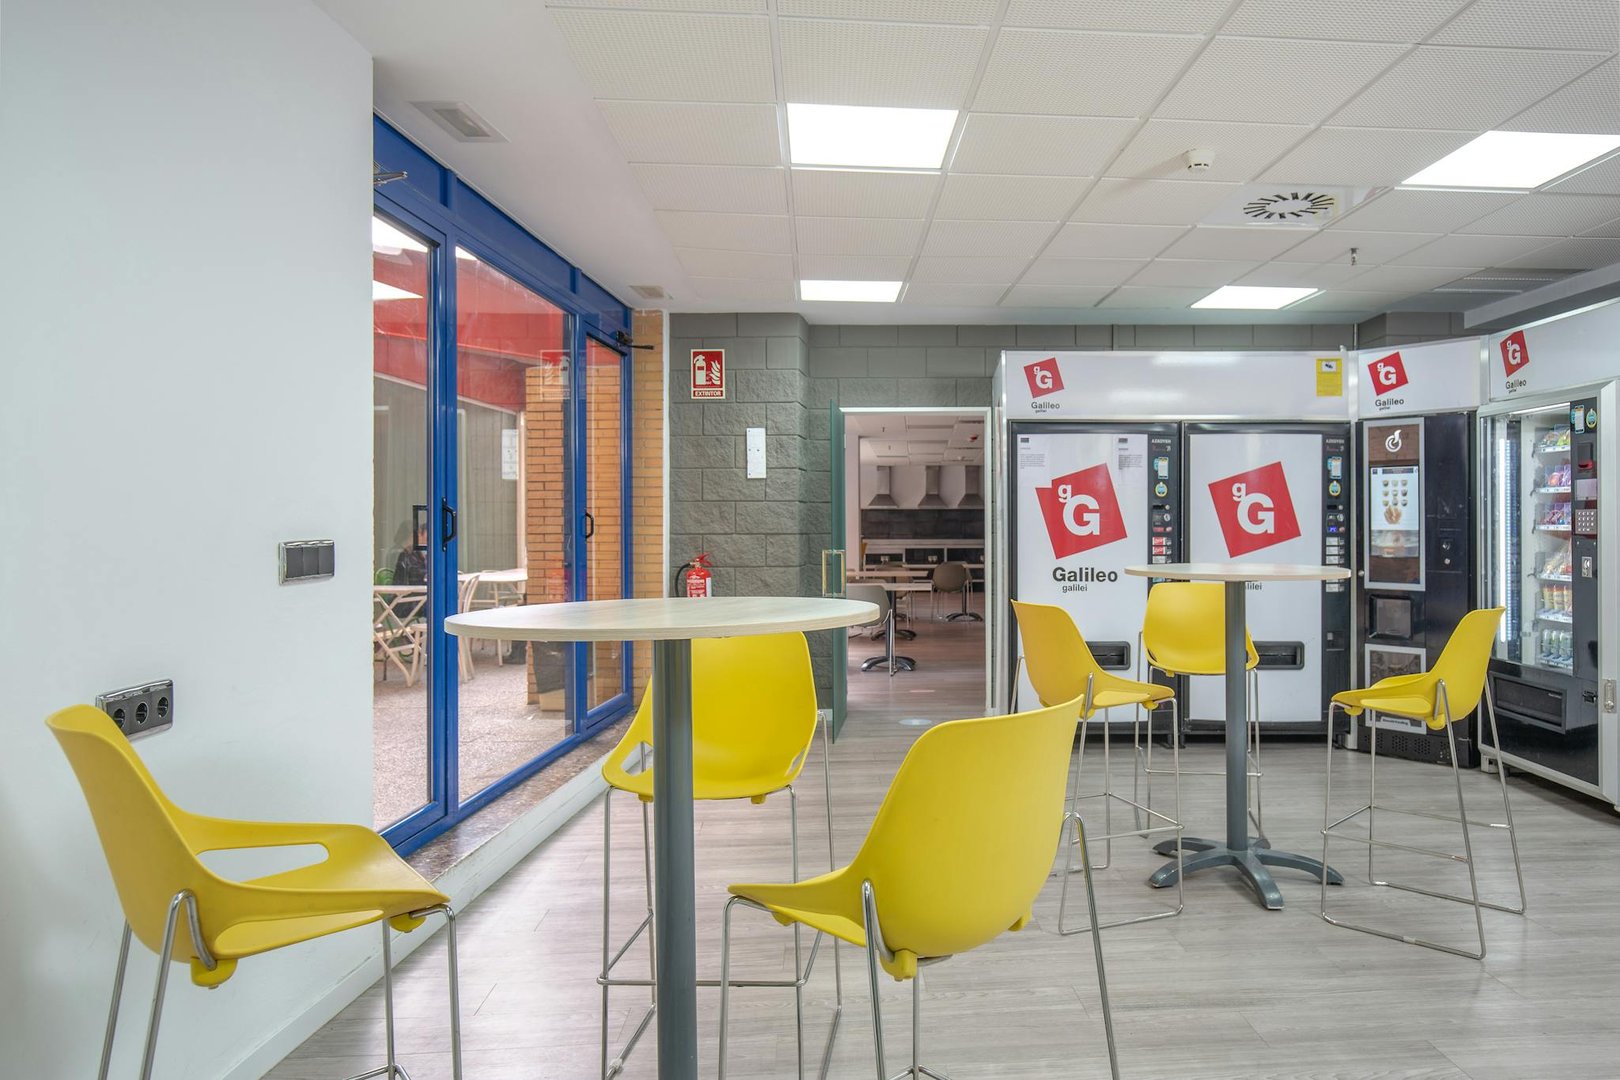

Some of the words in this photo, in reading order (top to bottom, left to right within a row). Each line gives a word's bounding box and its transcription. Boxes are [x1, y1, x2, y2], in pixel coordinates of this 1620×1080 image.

[1031, 401, 1061, 410] Galileo
[1375, 398, 1405, 407] Galileo
[1052, 566, 1118, 583] Galileo
[1062, 583, 1088, 594] galilei
[1245, 582, 1263, 591] lilei
